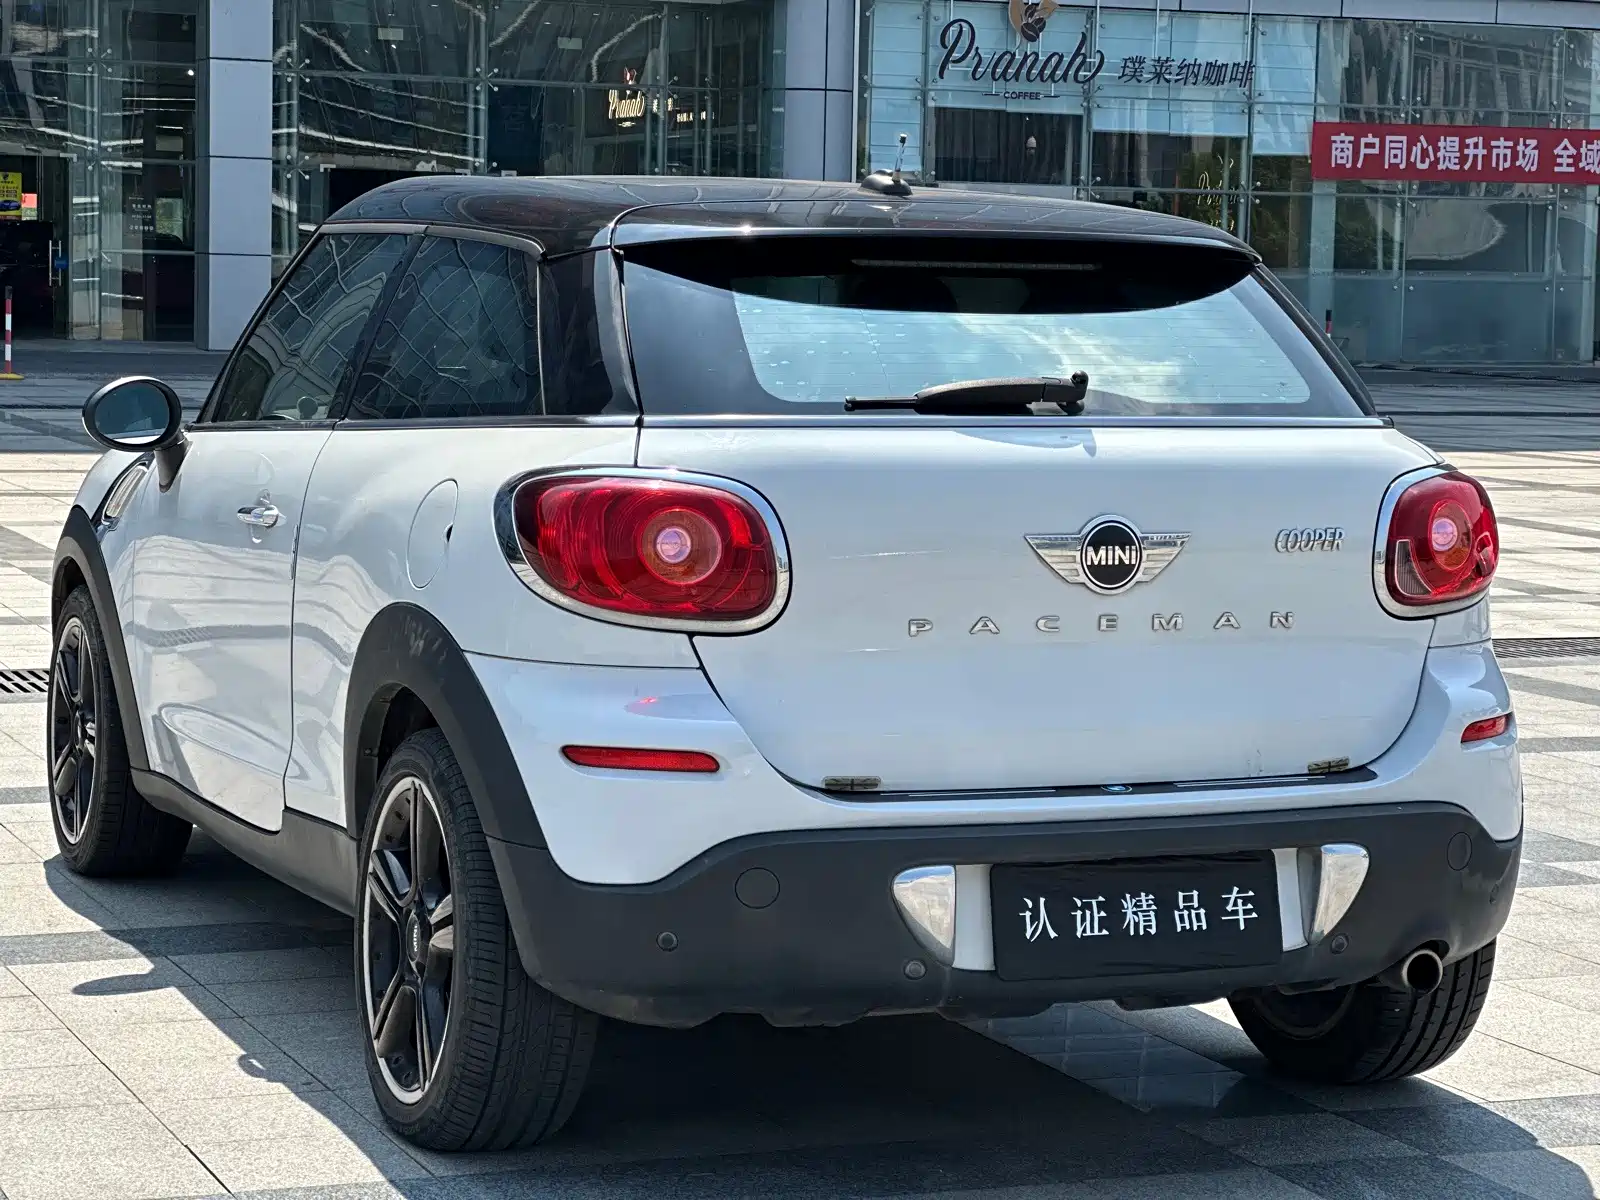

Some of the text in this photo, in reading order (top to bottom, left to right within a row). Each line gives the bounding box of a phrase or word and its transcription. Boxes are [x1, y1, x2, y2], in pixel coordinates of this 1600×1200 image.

[938, 18, 1105, 84] Pranah
[1117, 55, 1256, 89] 璞莱纳咖啡
[1003, 91, 1042, 101] COFFEE
[1330, 132, 1539, 173] 商户同心提升市场
[1086, 545, 1137, 566] MINI
[1274, 527, 1346, 554] COOPER
[907, 611, 1295, 638] PACEMAN
[1018, 886, 1259, 943] 认证精品车
